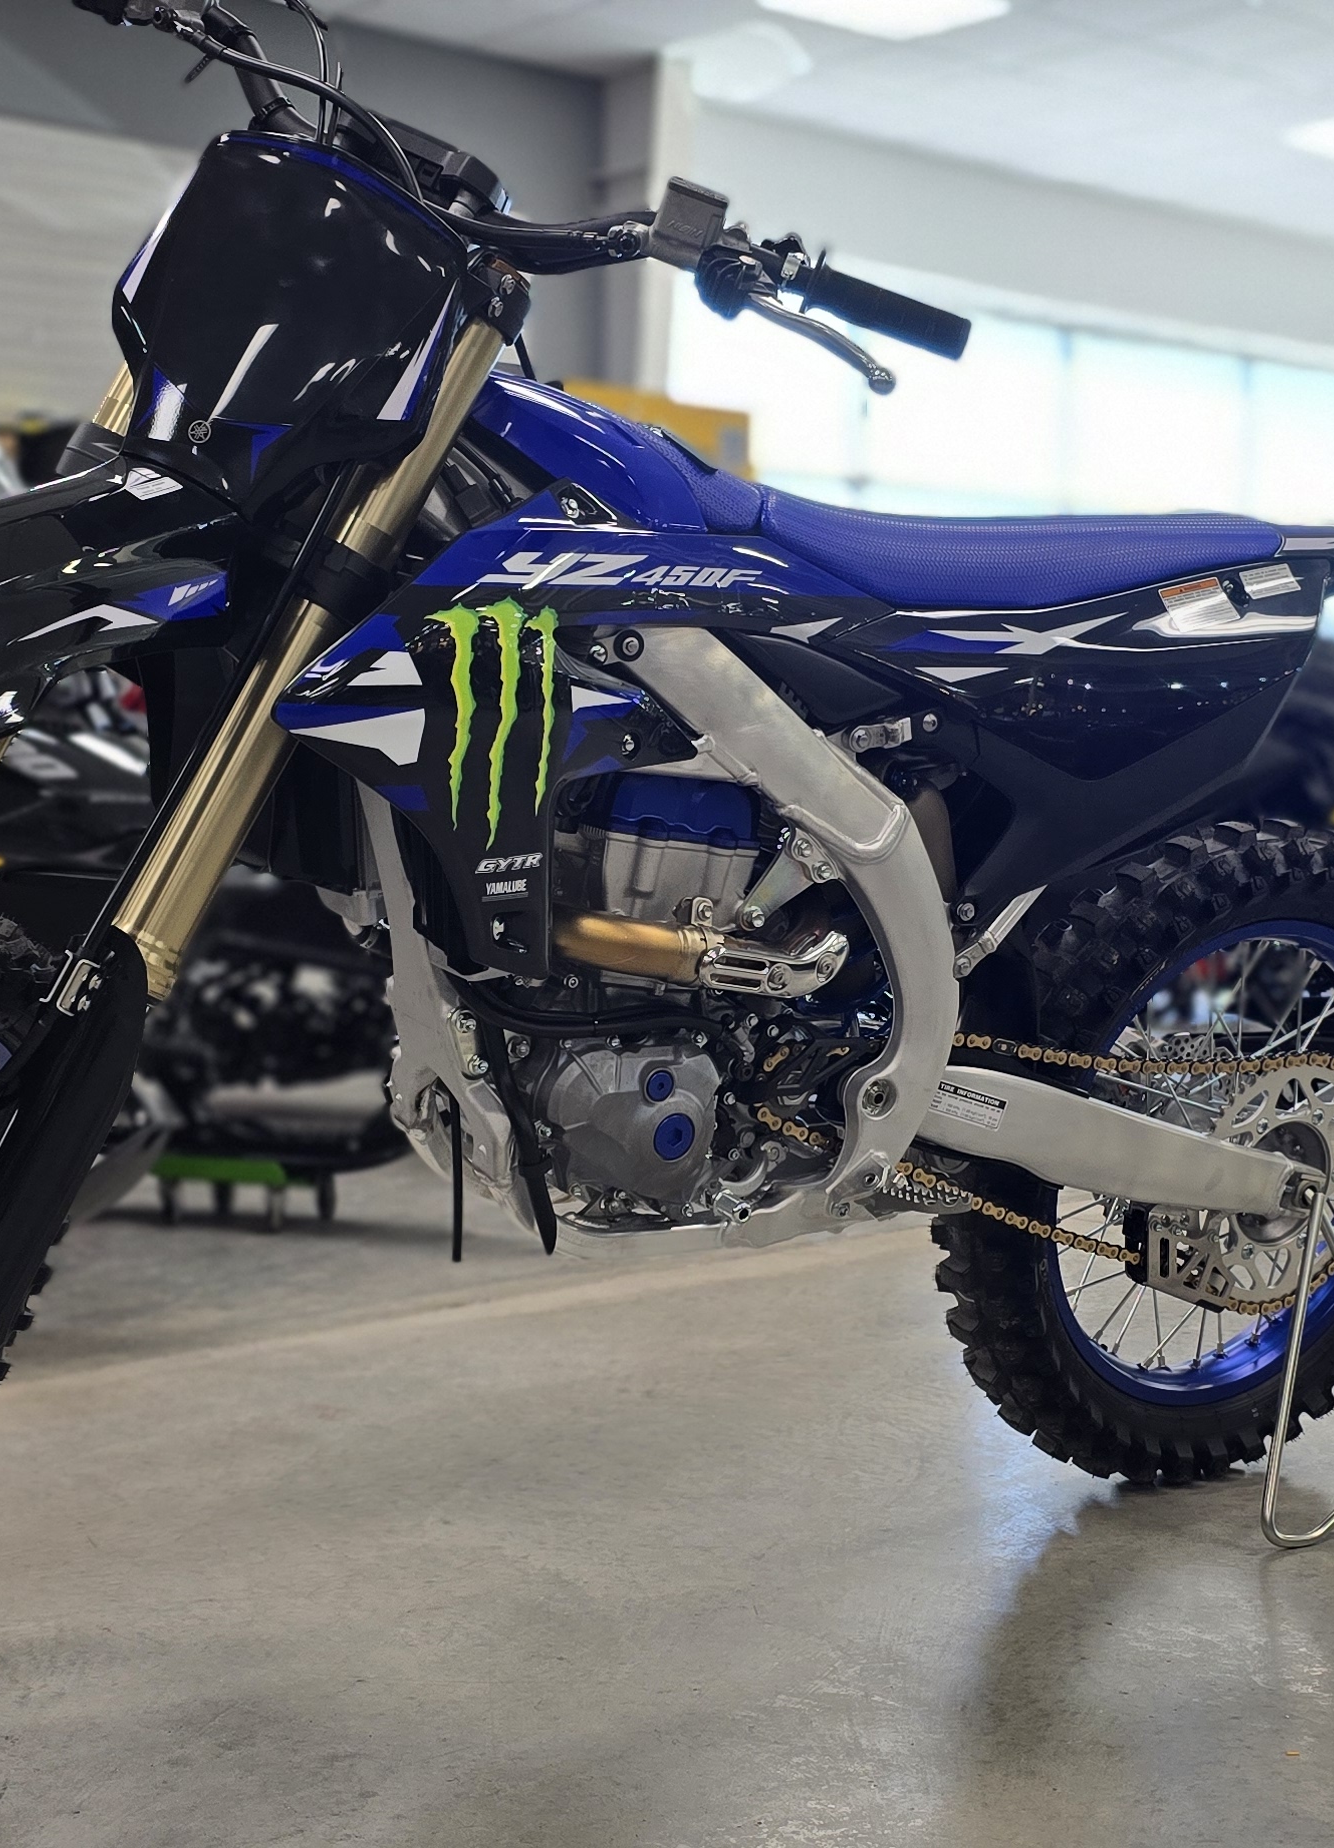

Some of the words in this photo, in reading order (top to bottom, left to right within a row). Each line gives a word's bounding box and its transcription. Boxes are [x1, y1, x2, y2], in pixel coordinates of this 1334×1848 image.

[476, 551, 649, 589] YZ
[630, 565, 763, 589] 450F
[474, 852, 544, 875] GYTR
[485, 878, 528, 896] YAMALUBE
[940, 1082, 956, 1093] TIRE
[957, 1088, 1001, 1107] INFORMATION
